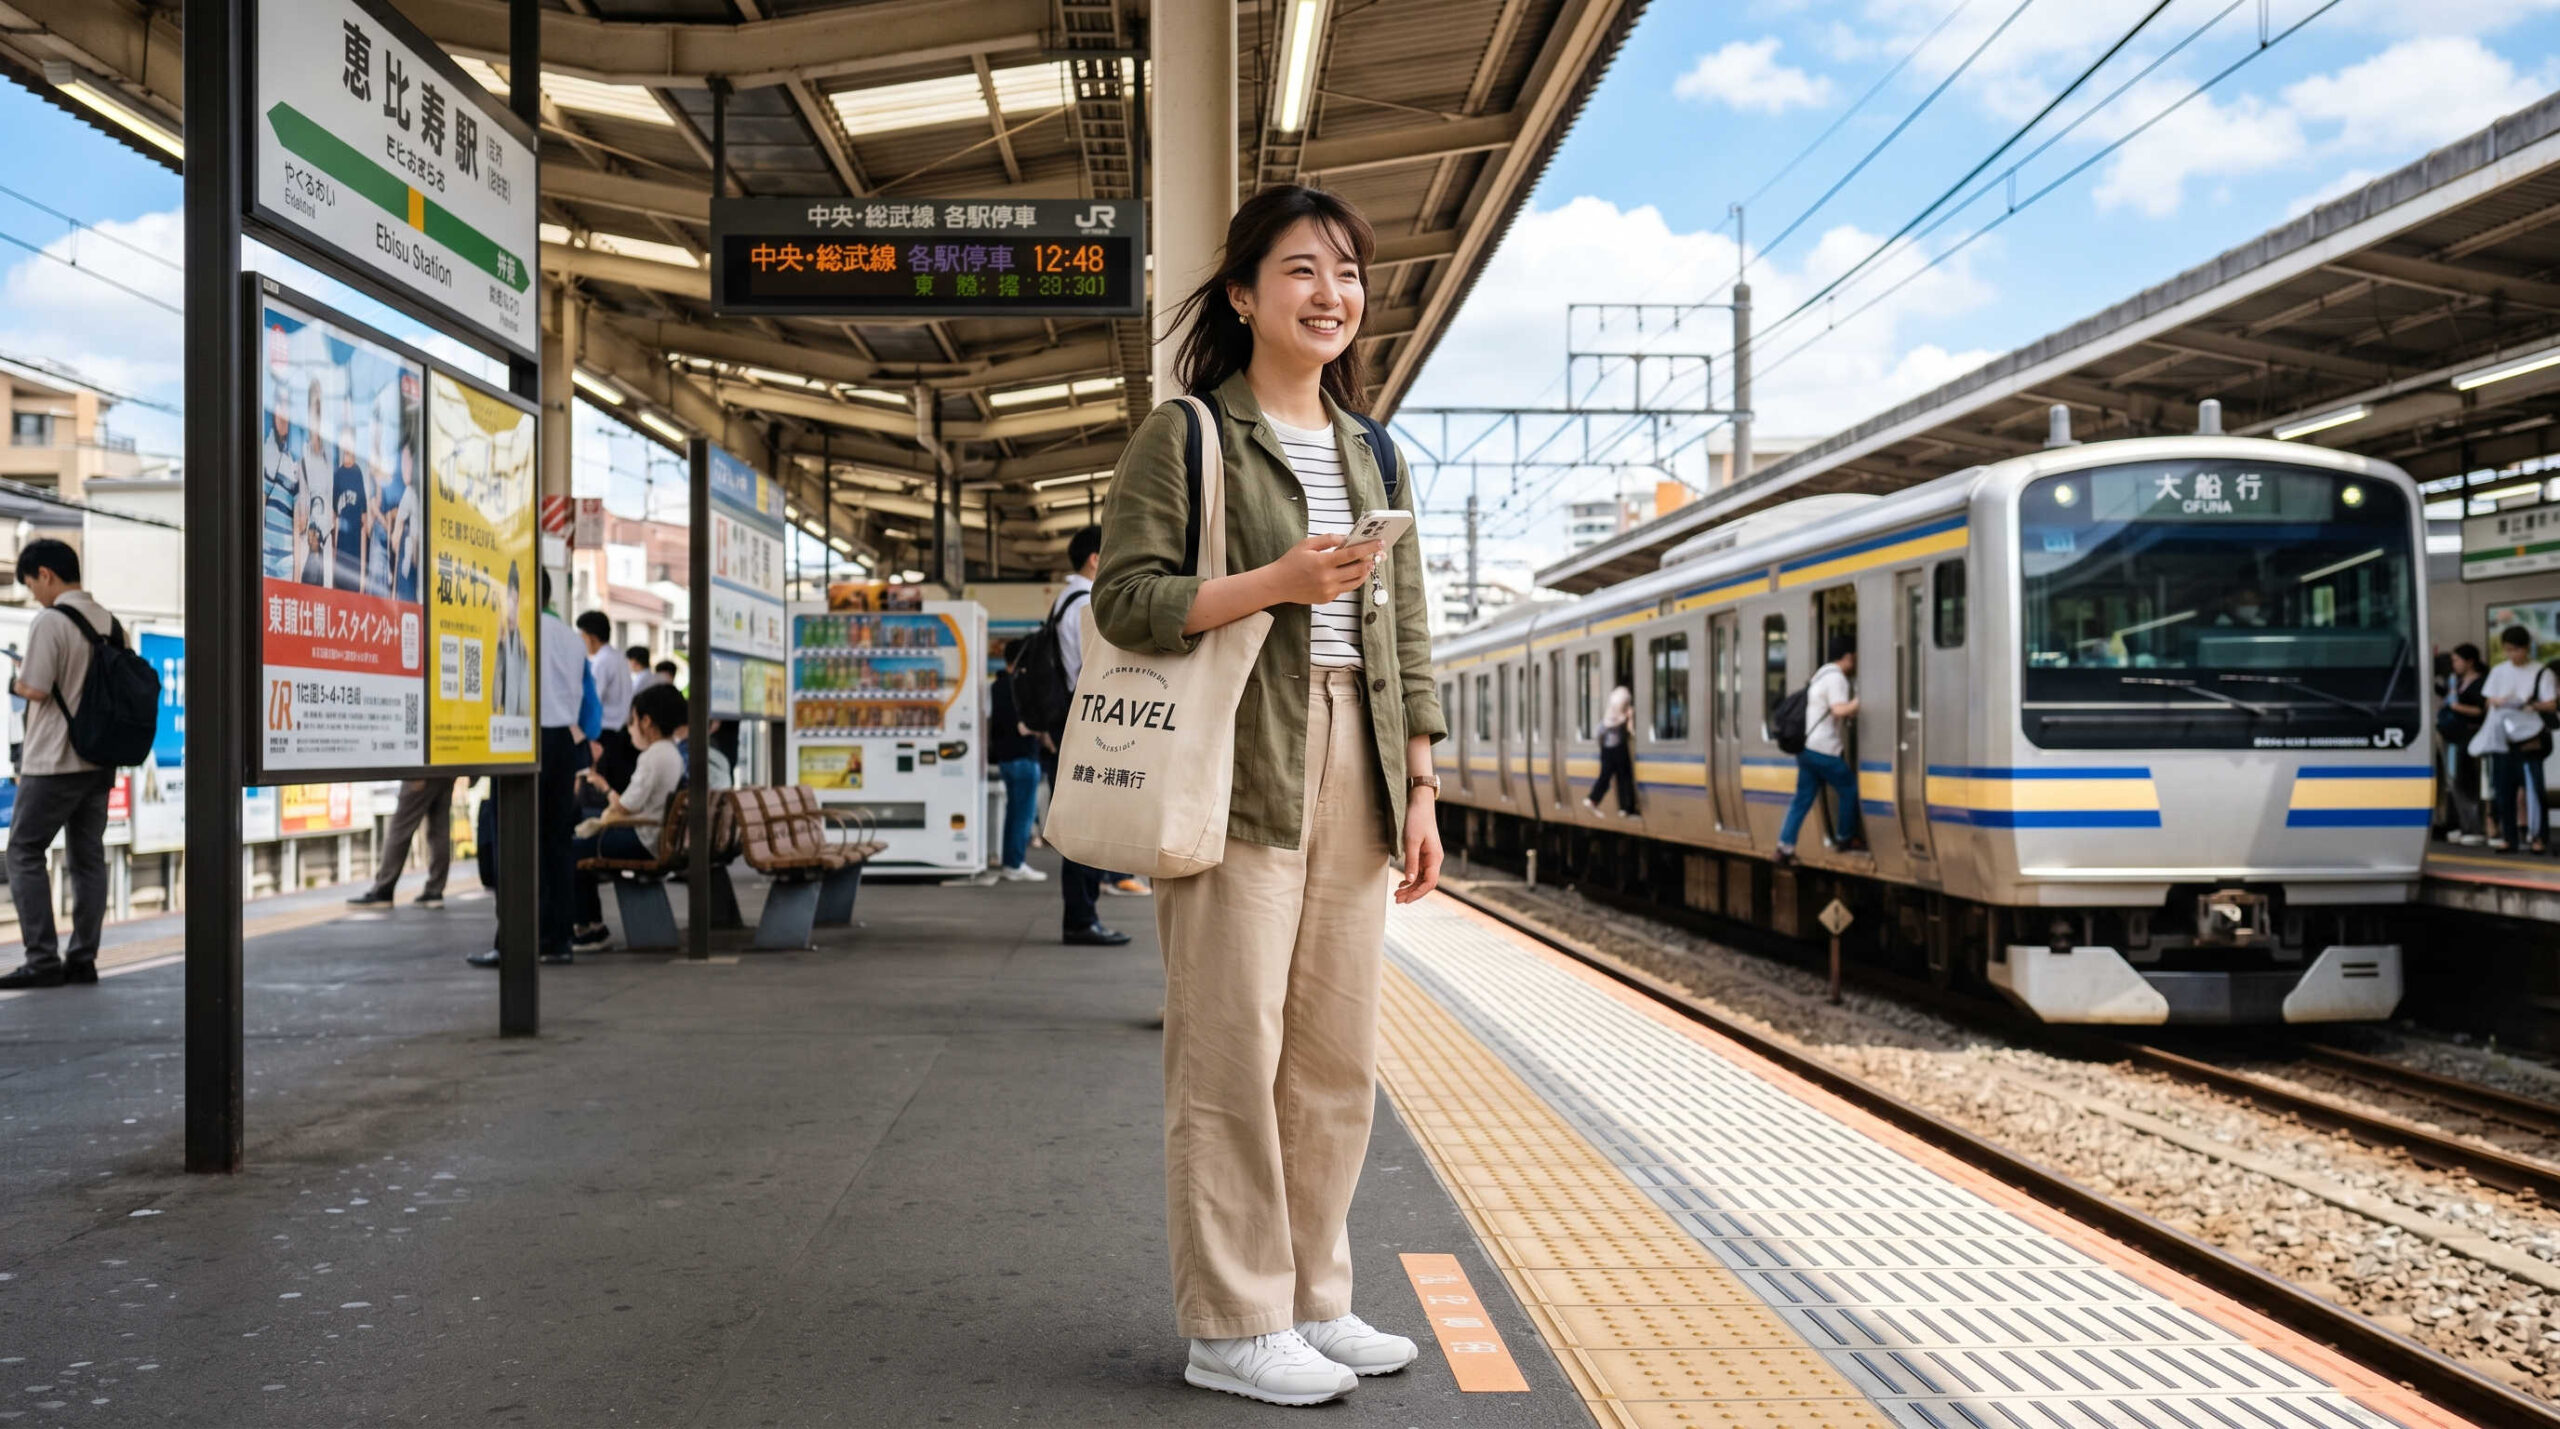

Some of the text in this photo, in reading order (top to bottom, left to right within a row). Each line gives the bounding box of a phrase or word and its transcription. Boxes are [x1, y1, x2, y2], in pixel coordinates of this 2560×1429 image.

[343, 19, 478, 181] 恵比寿駅
[807, 204, 1037, 229] 中央・総武線 各駅停車
[1075, 205, 1116, 228] JR
[376, 222, 409, 265] Ebisu
[413, 244, 452, 288] Station
[751, 243, 1104, 272] 中央・総武線 各駅停車 12:48
[2155, 473, 2262, 500] 大船行
[2182, 500, 2233, 513] OFUNA
[1081, 694, 1177, 731] TRAVEL
[2373, 727, 2404, 747] JR
